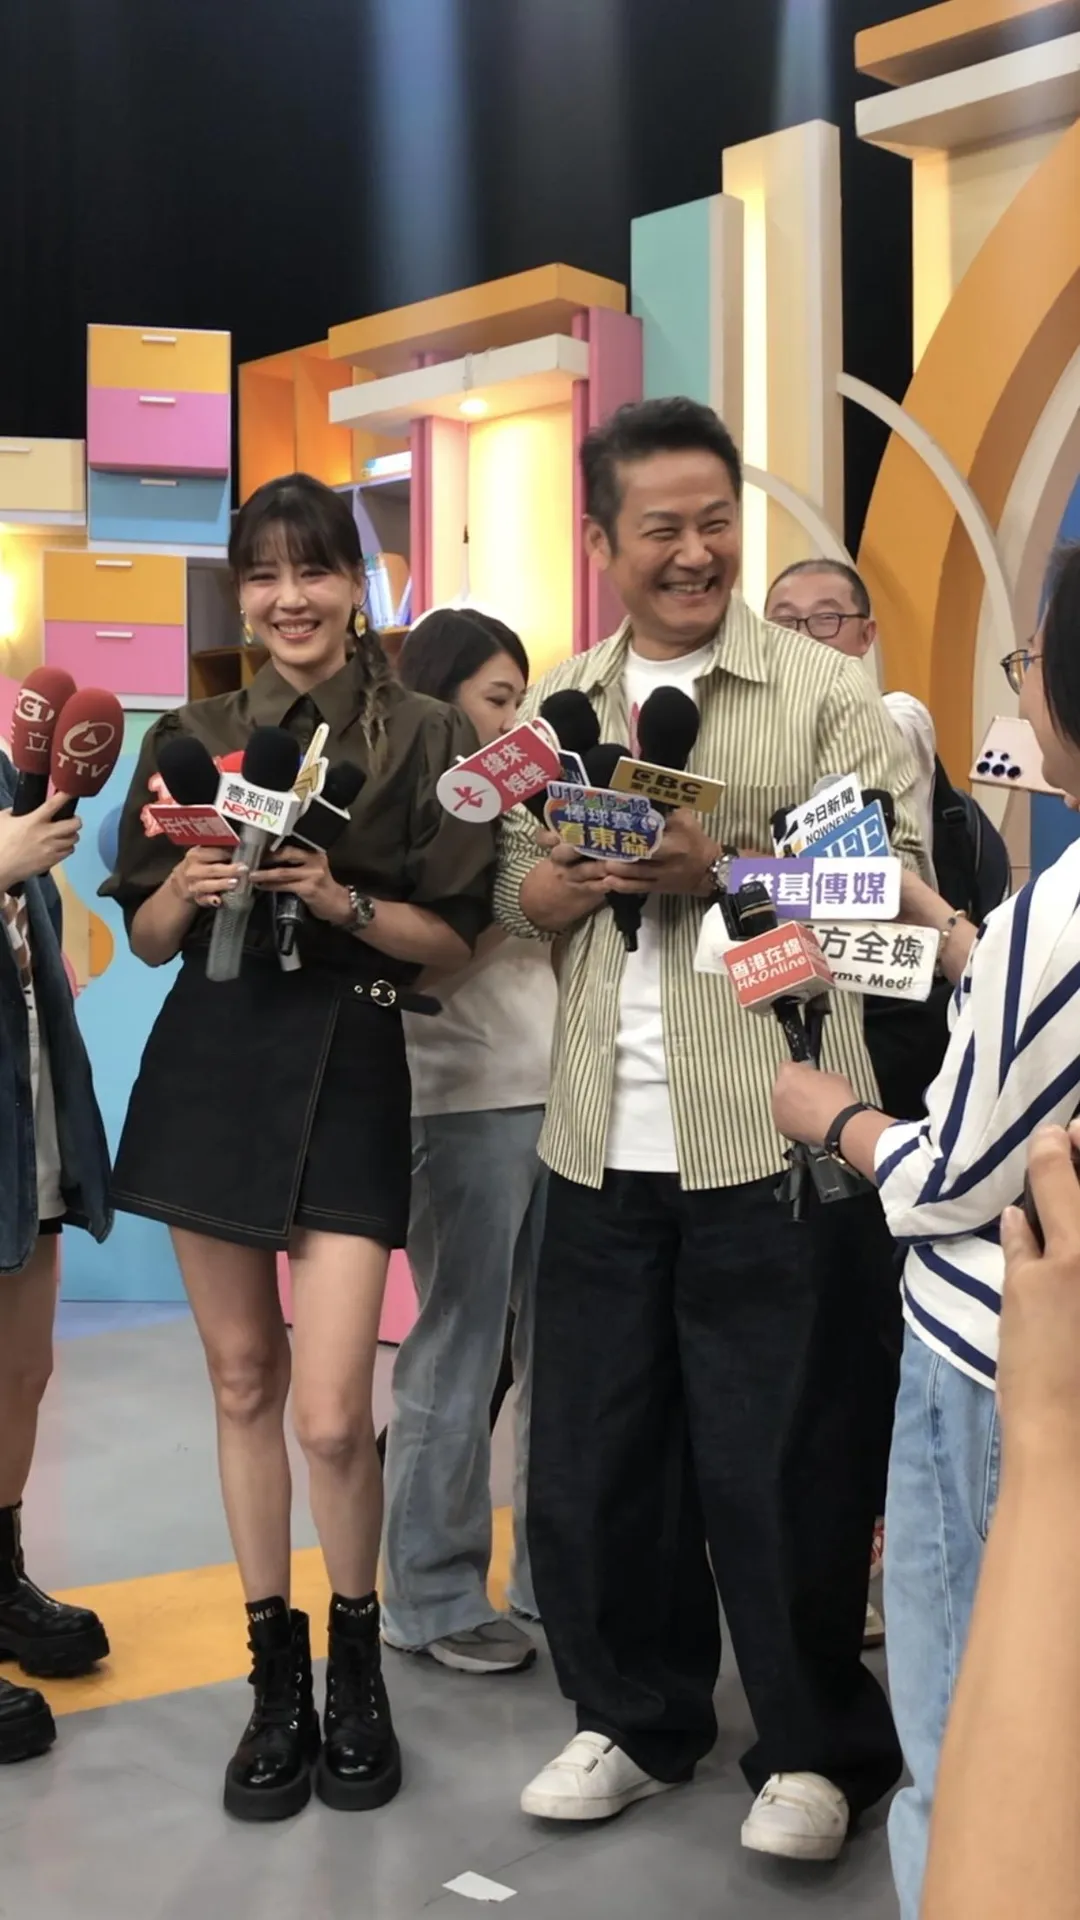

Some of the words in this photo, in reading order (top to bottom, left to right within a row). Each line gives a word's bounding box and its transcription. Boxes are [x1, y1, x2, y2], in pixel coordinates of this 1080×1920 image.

[57, 752, 109, 778] TTV
[632, 768, 703, 795] EBC
[226, 783, 284, 816] 壹新聞
[803, 786, 855, 828] 今日新聞
[805, 924, 924, 969] 方全媒
